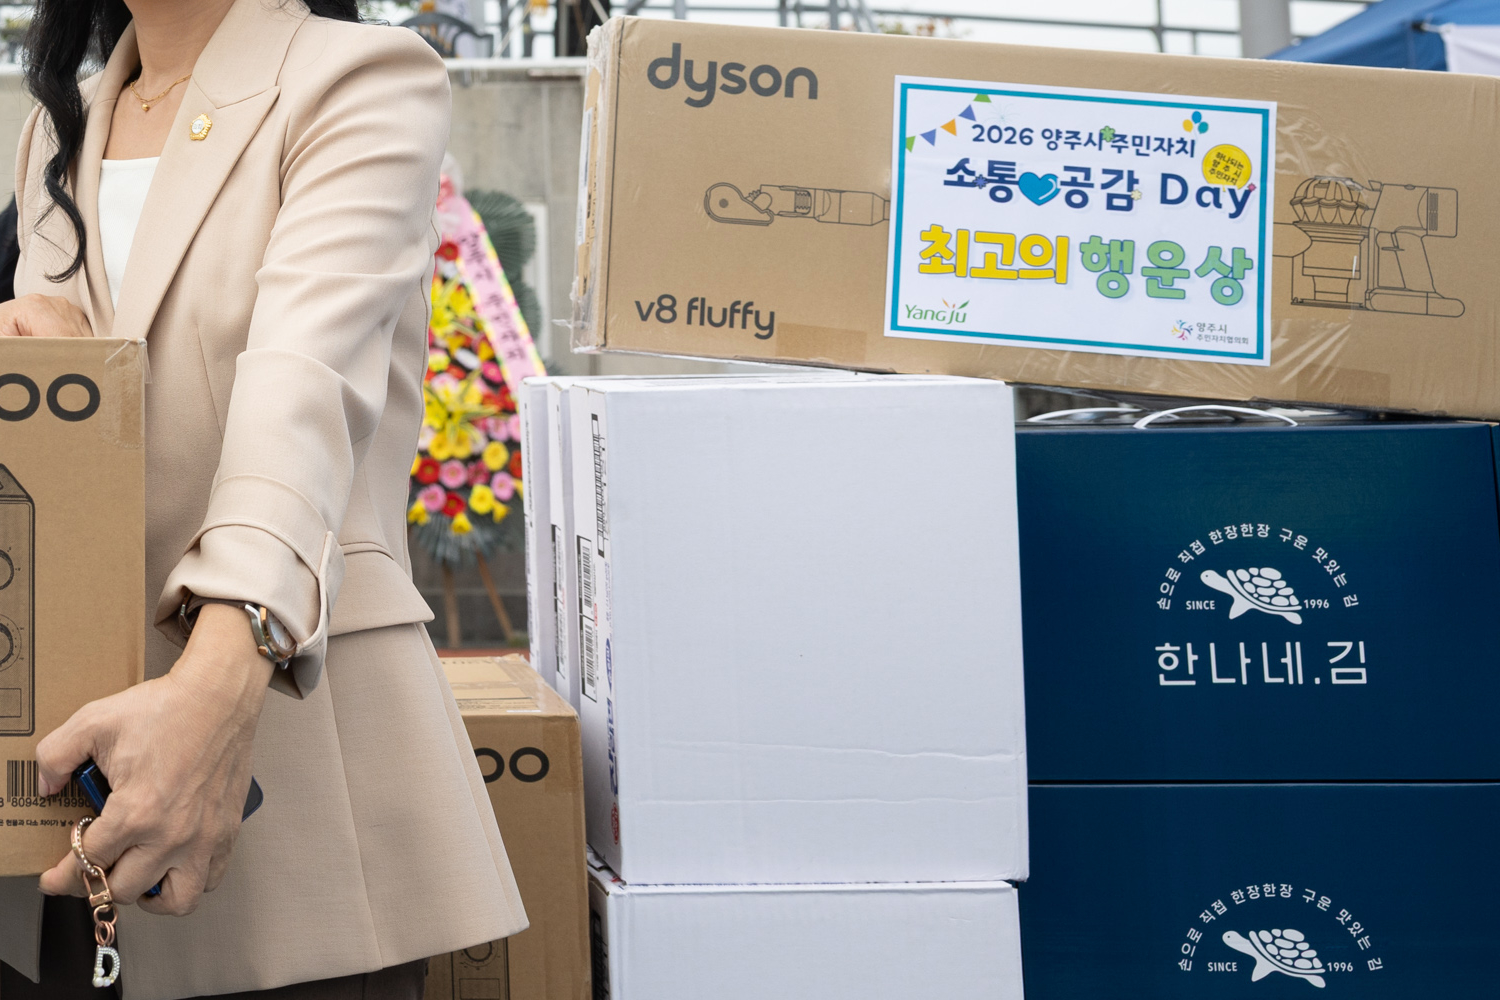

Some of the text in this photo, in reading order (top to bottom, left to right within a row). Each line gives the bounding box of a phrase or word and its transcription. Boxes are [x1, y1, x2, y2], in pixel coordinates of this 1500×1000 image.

[646, 41, 819, 108] dyson
[971, 123, 1197, 159] 2026 양주시 주민자치
[943, 157, 1255, 219] 소통 공감 Day
[917, 223, 1255, 307] 최고의 행운상
[633, 293, 776, 341] v8 fluffy
[1177, 539, 1206, 564] 직접
[1208, 523, 1271, 545] 한장한장
[1278, 527, 1309, 551] 구운
[1311, 547, 1348, 588] 맛있는
[1343, 594, 1359, 608] 김
[1185, 599, 1330, 611] SINCE 1996
[11, 796, 53, 808] 809421
[1198, 899, 1228, 924] 직접
[1230, 883, 1293, 905] 한장한장
[1302, 888, 1332, 912] 구운
[1335, 908, 1372, 951] 맛있는
[1367, 957, 1384, 972] 김
[1207, 961, 1354, 973] SINCE 1996
